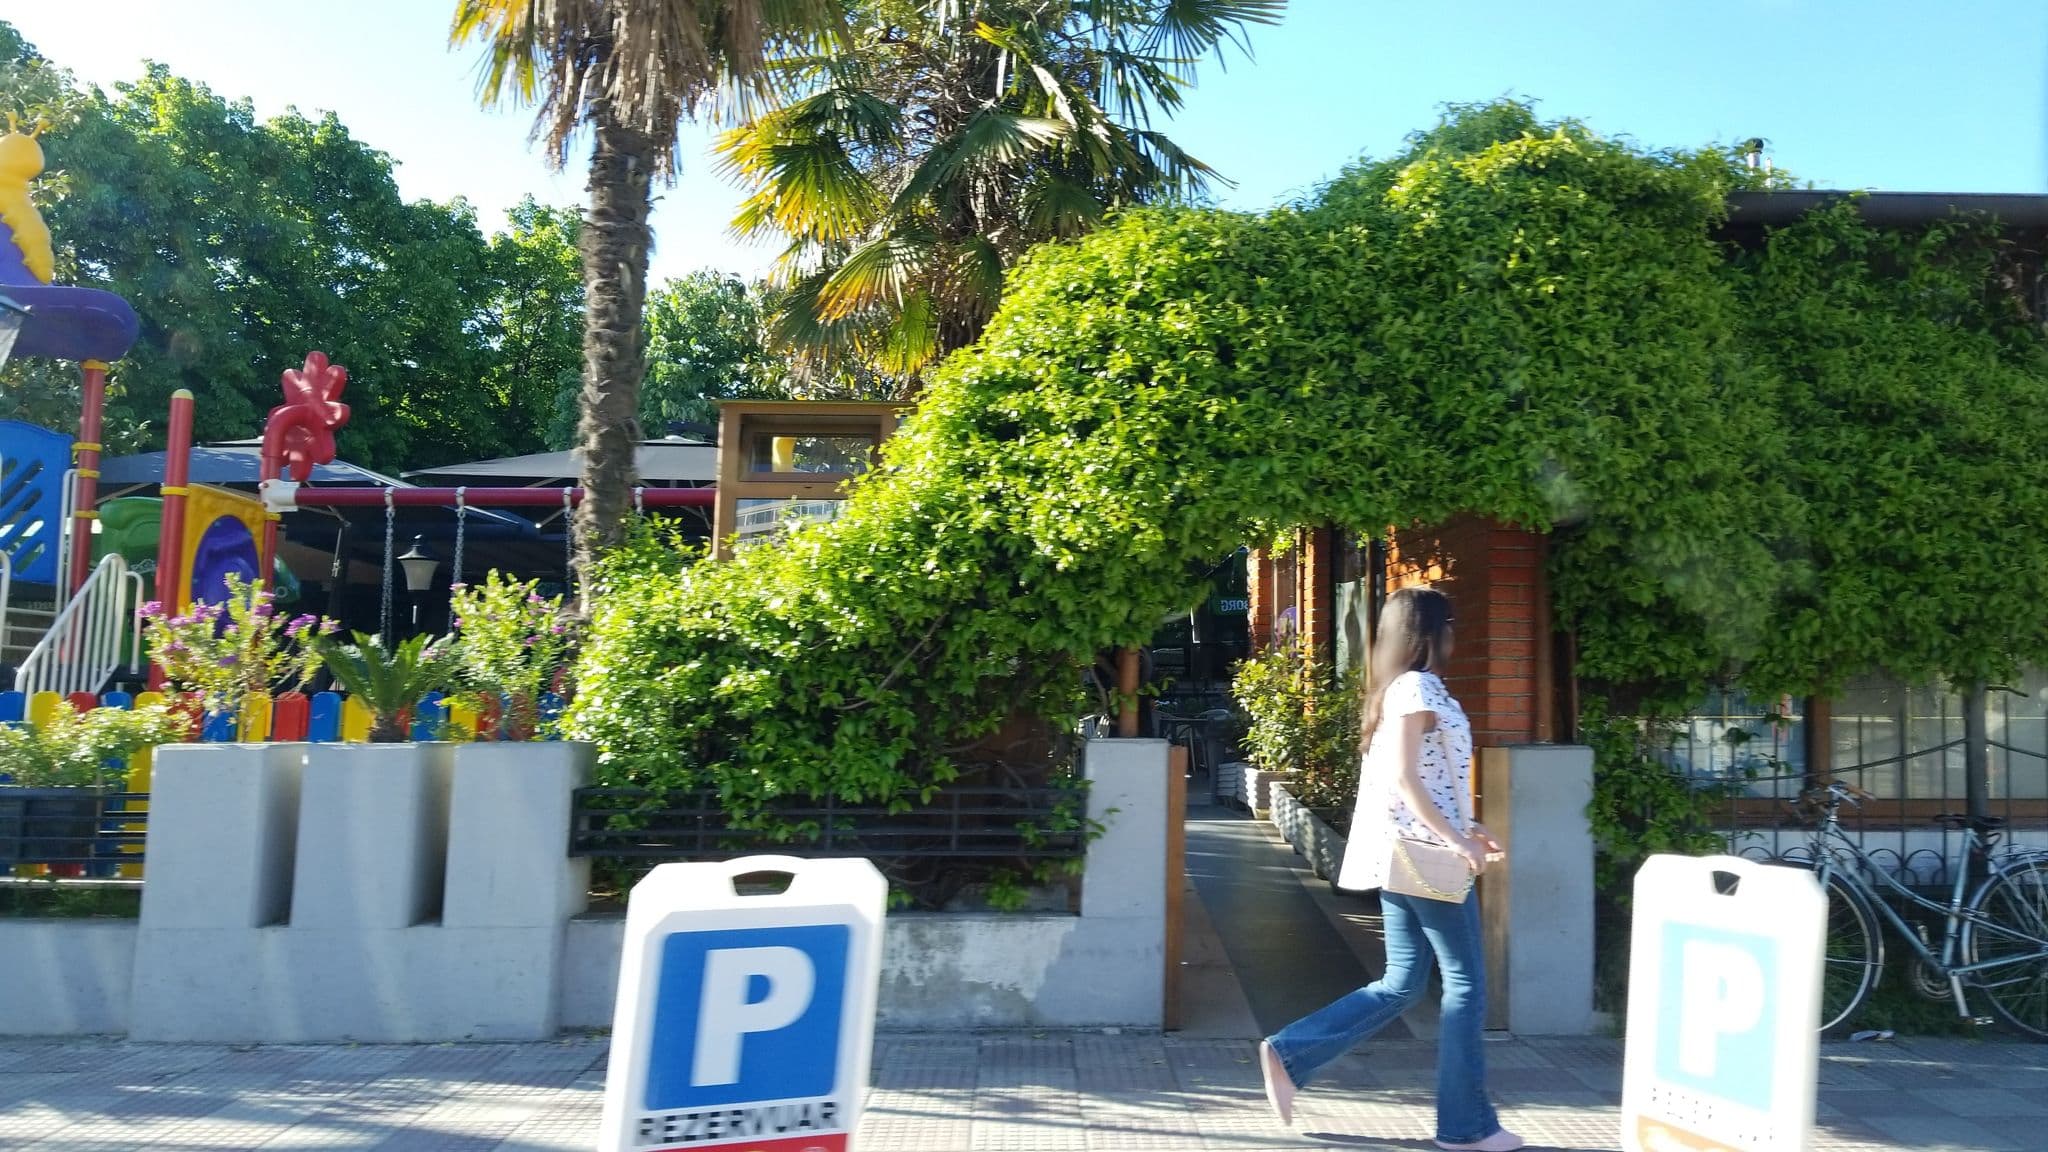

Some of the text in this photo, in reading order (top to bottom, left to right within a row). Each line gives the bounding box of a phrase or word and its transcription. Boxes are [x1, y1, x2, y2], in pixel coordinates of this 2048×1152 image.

[690, 946, 816, 1087] P
[1678, 939, 1764, 1078] P
[635, 1102, 838, 1146] REZERVUAR
